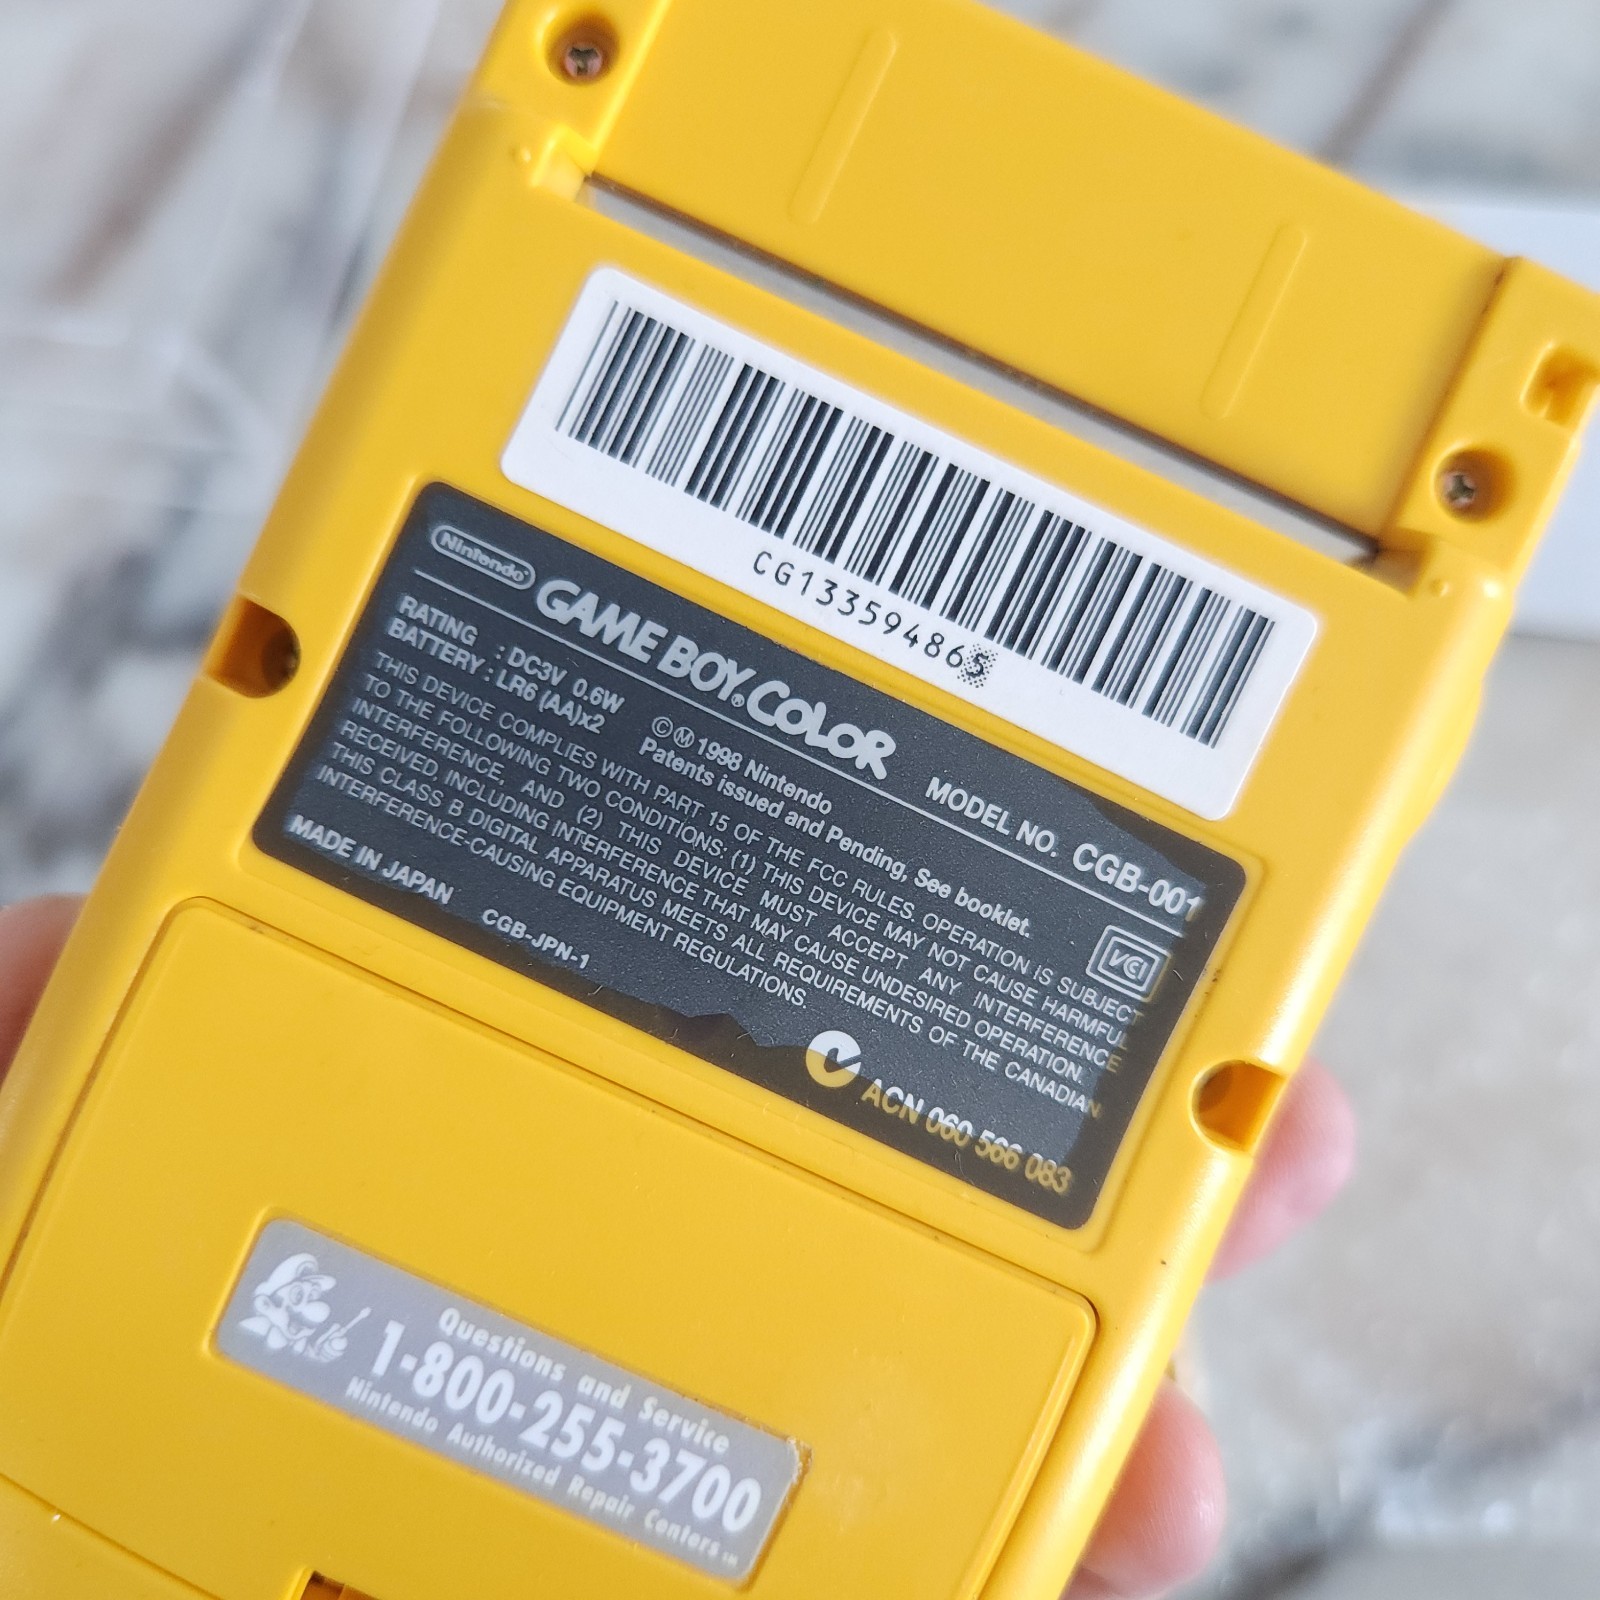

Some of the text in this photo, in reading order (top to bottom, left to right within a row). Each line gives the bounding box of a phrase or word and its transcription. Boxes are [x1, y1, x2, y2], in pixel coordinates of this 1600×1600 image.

[440, 532, 528, 582] Nintendo
[753, 551, 989, 679] CG133594865
[388, 617, 486, 675] BATTERY
[495, 668, 539, 702] LR6
[399, 595, 478, 647] RATING
[507, 646, 568, 686] DC3V
[572, 678, 625, 714] 0.6W
[536, 579, 669, 664] GAME
[746, 679, 897, 780] COLOR
[377, 651, 1144, 1022] THIS DEVICE COMPLIES WITH PART 15 OF THE FCC RULES. OPERATION IS SUBJECT
[638, 736, 1030, 938] Patents issued and Pending, See booklet.
[697, 738, 743, 772] 1998
[743, 759, 832, 815] Nintendo
[925, 776, 1201, 914] MODEL NO. CGB-001
[288, 814, 454, 905] MADE IN JAPAN
[316, 765, 807, 1009] INTERFERENCE-CAUSING EQUIPMENT REGULATIONS.
[332, 741, 1101, 1118] THIS CLASS B DIGITAL APPARATUS MEETS ALL REQUIREMENTS OF THE CANADIAN
[340, 720, 1083, 1084] RECEIVED, INCLUDING INTERFERENCE THAT MAY CAUSE UNDESIRED OPERATION.
[352, 698, 1122, 1073] INTERFERENCE, AND (2) THIS DEVICE MUST ACCEPT ANY INTERFERENCE
[366, 673, 1128, 1051] TO THE FOLLOWING TWO CONDITIONS: (1) THIS DEVICE MAY NOT CAUSE HARMFUL
[481, 908, 590, 969] CGB-JPN-1
[861, 1078, 1072, 1193] ACN 060 566 083
[371, 1320, 761, 1533] 1-800-255-3700
[438, 1307, 729, 1455] Questions and Service
[345, 1376, 720, 1557] Nintendo Authorized Repair Centers
